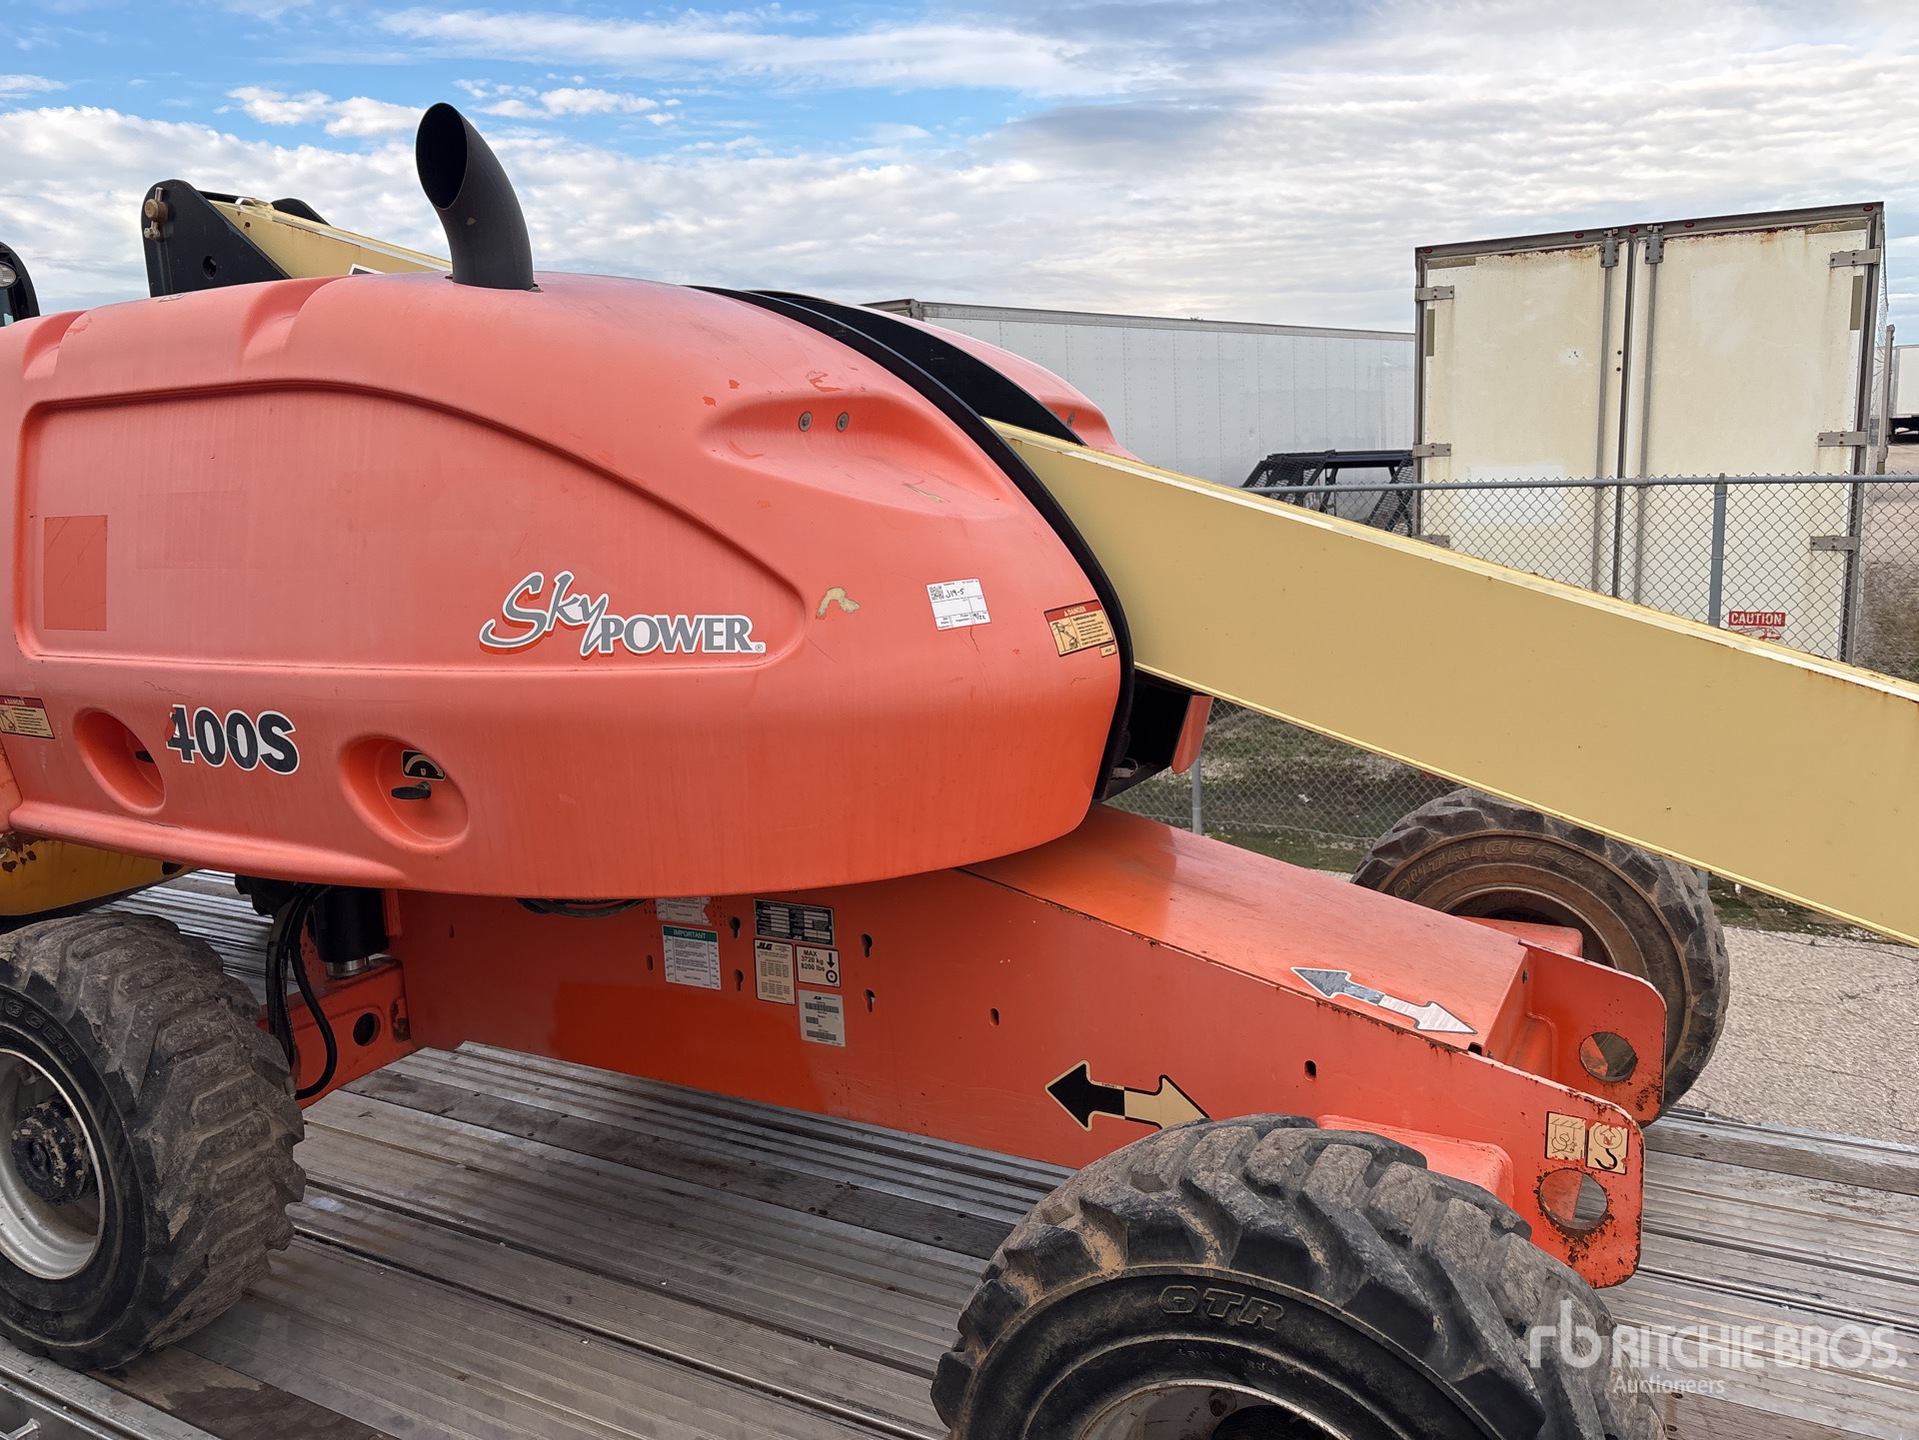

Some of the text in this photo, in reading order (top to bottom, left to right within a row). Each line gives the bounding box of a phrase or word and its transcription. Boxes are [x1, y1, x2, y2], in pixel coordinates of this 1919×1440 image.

[479, 570, 610, 660] Sky
[1731, 612, 1782, 625] CAUTION
[165, 704, 300, 775] 400S
[1394, 840, 1583, 897] OUTRIGGER
[673, 929, 707, 940] IMPORTANT
[756, 942, 773, 951] JLG
[803, 949, 818, 957] MAX
[816, 957, 824, 966] kg
[1159, 1285, 1285, 1332] OTR
